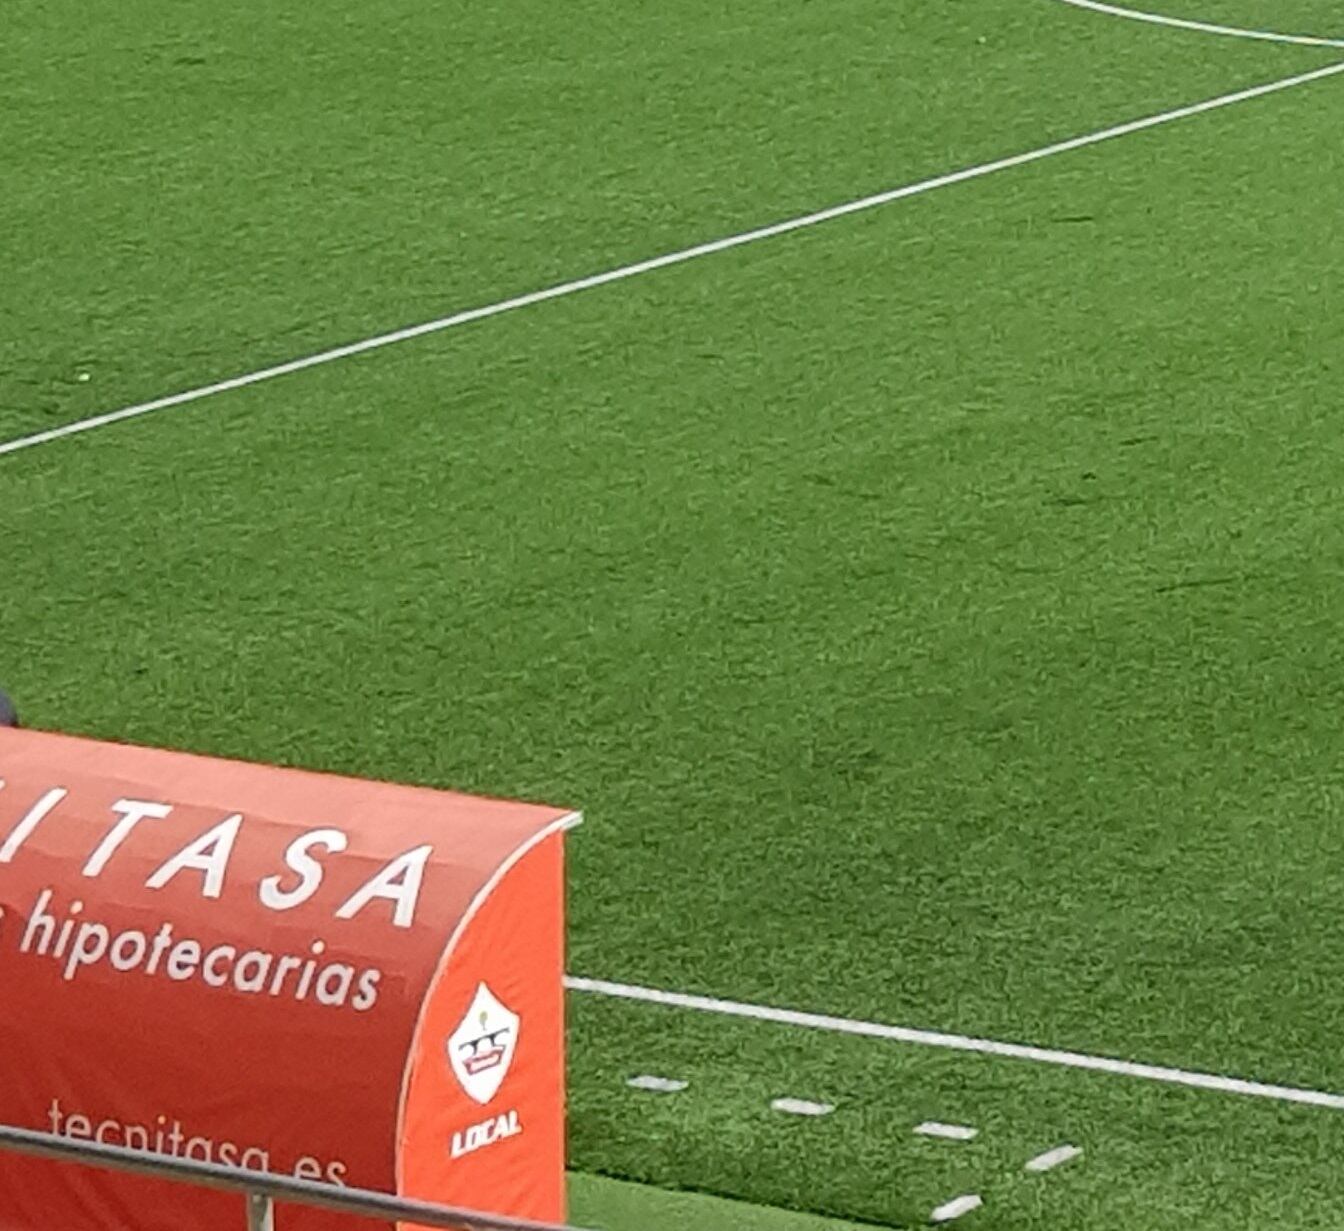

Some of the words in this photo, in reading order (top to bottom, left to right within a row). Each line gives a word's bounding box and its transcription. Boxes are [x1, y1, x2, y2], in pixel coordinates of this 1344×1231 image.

[0, 780, 433, 929] ITASA
[19, 888, 382, 1012] hipotecarias
[48, 1098, 348, 1189] tecnitasaes
[449, 1109, 523, 1160] LOCAL
